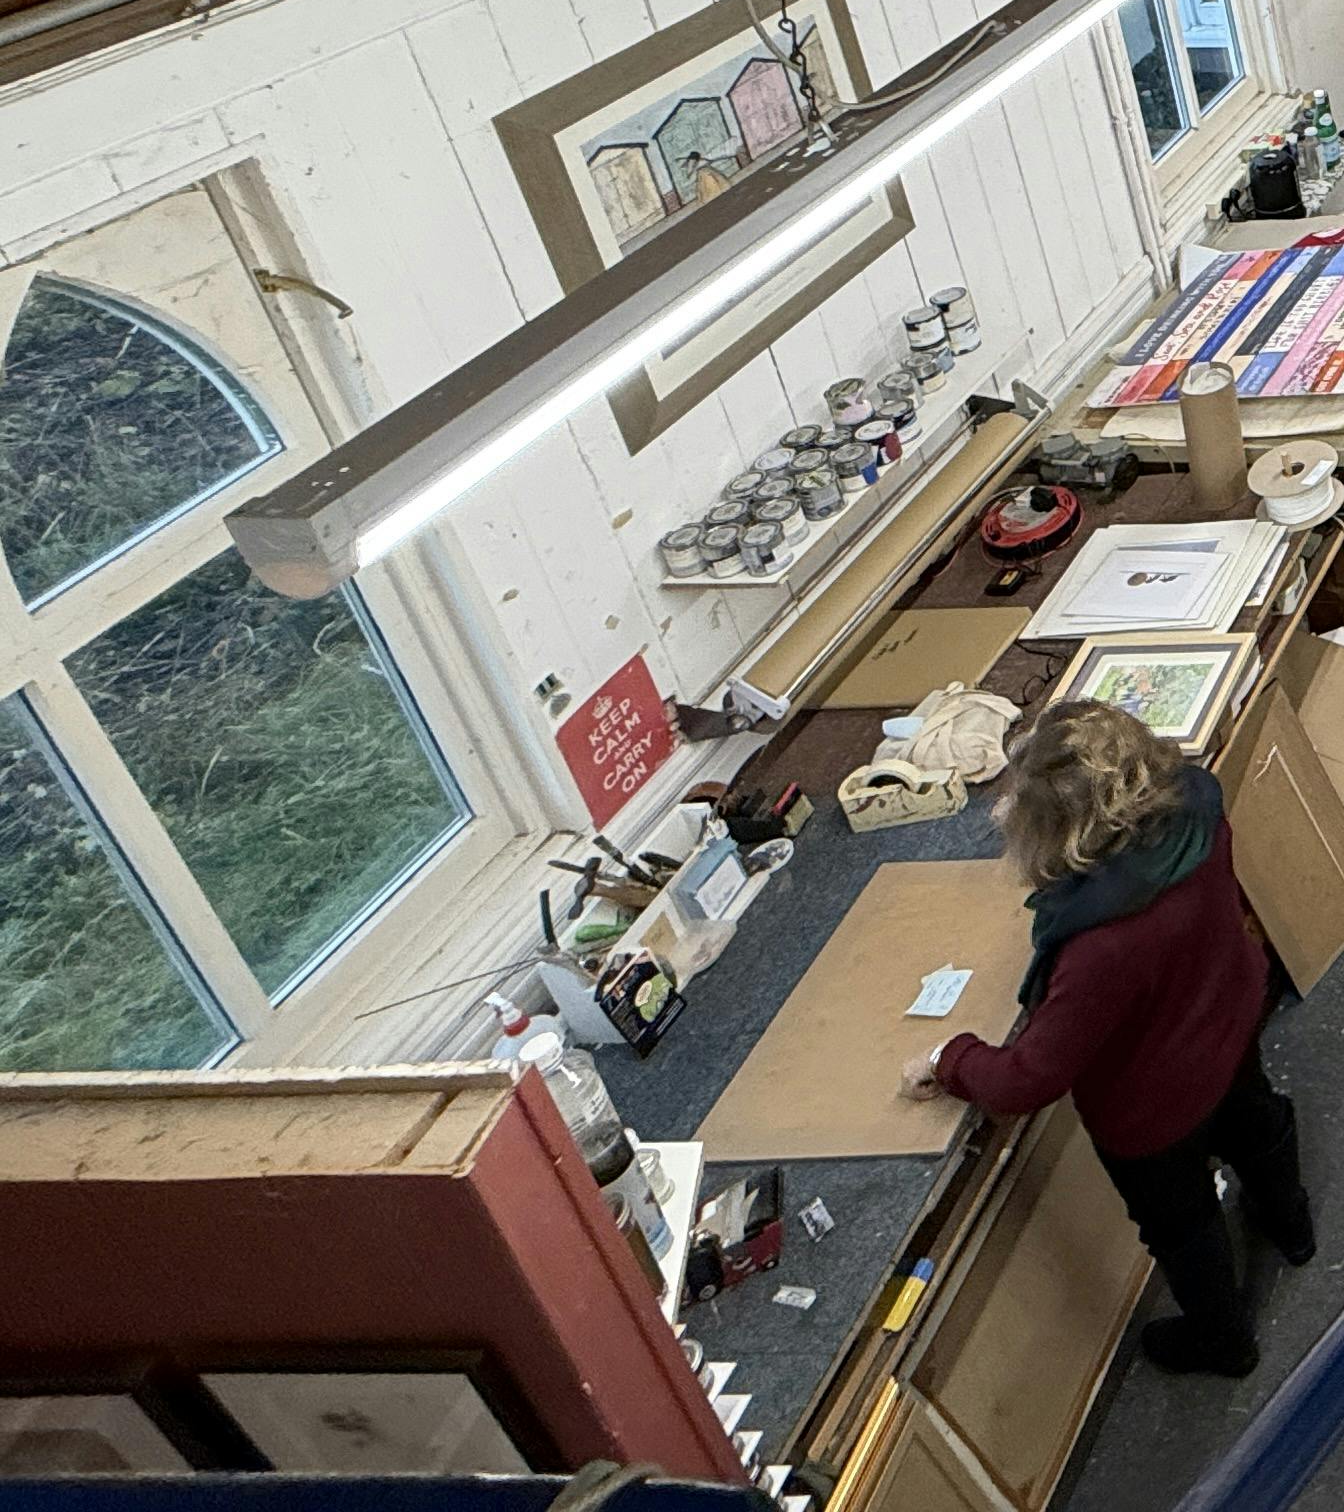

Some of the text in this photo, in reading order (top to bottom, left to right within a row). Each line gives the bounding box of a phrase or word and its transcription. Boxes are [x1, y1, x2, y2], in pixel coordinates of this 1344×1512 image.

[588, 698, 631, 747] KEEP
[593, 711, 641, 765] CALM
[603, 730, 652, 791] CARRY
[614, 738, 632, 761] AND
[622, 761, 648, 792] ON
